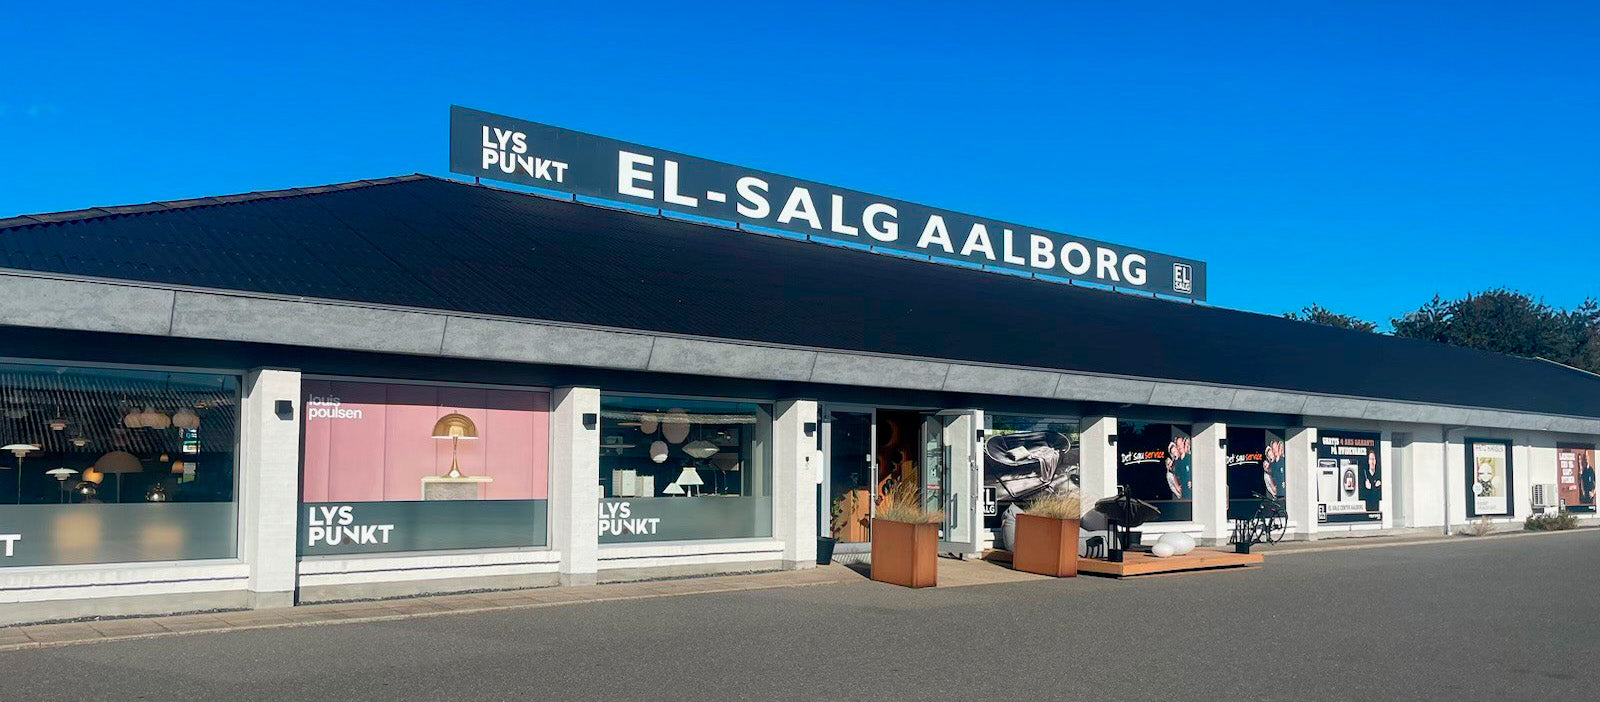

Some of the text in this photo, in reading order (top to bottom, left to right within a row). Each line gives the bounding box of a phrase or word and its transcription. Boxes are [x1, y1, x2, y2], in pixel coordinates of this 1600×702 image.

[483, 126, 527, 153] LYS
[483, 148, 568, 183] PUNKT
[618, 150, 1146, 285] EL-SALG AALBORG
[1175, 266, 1190, 283] EL
[309, 394, 341, 406] louis
[309, 407, 362, 420] poulsen
[310, 506, 354, 525] LYS
[599, 502, 631, 518] LYS
[309, 525, 394, 546] PUNKT
[599, 518, 660, 536] PUNKT
